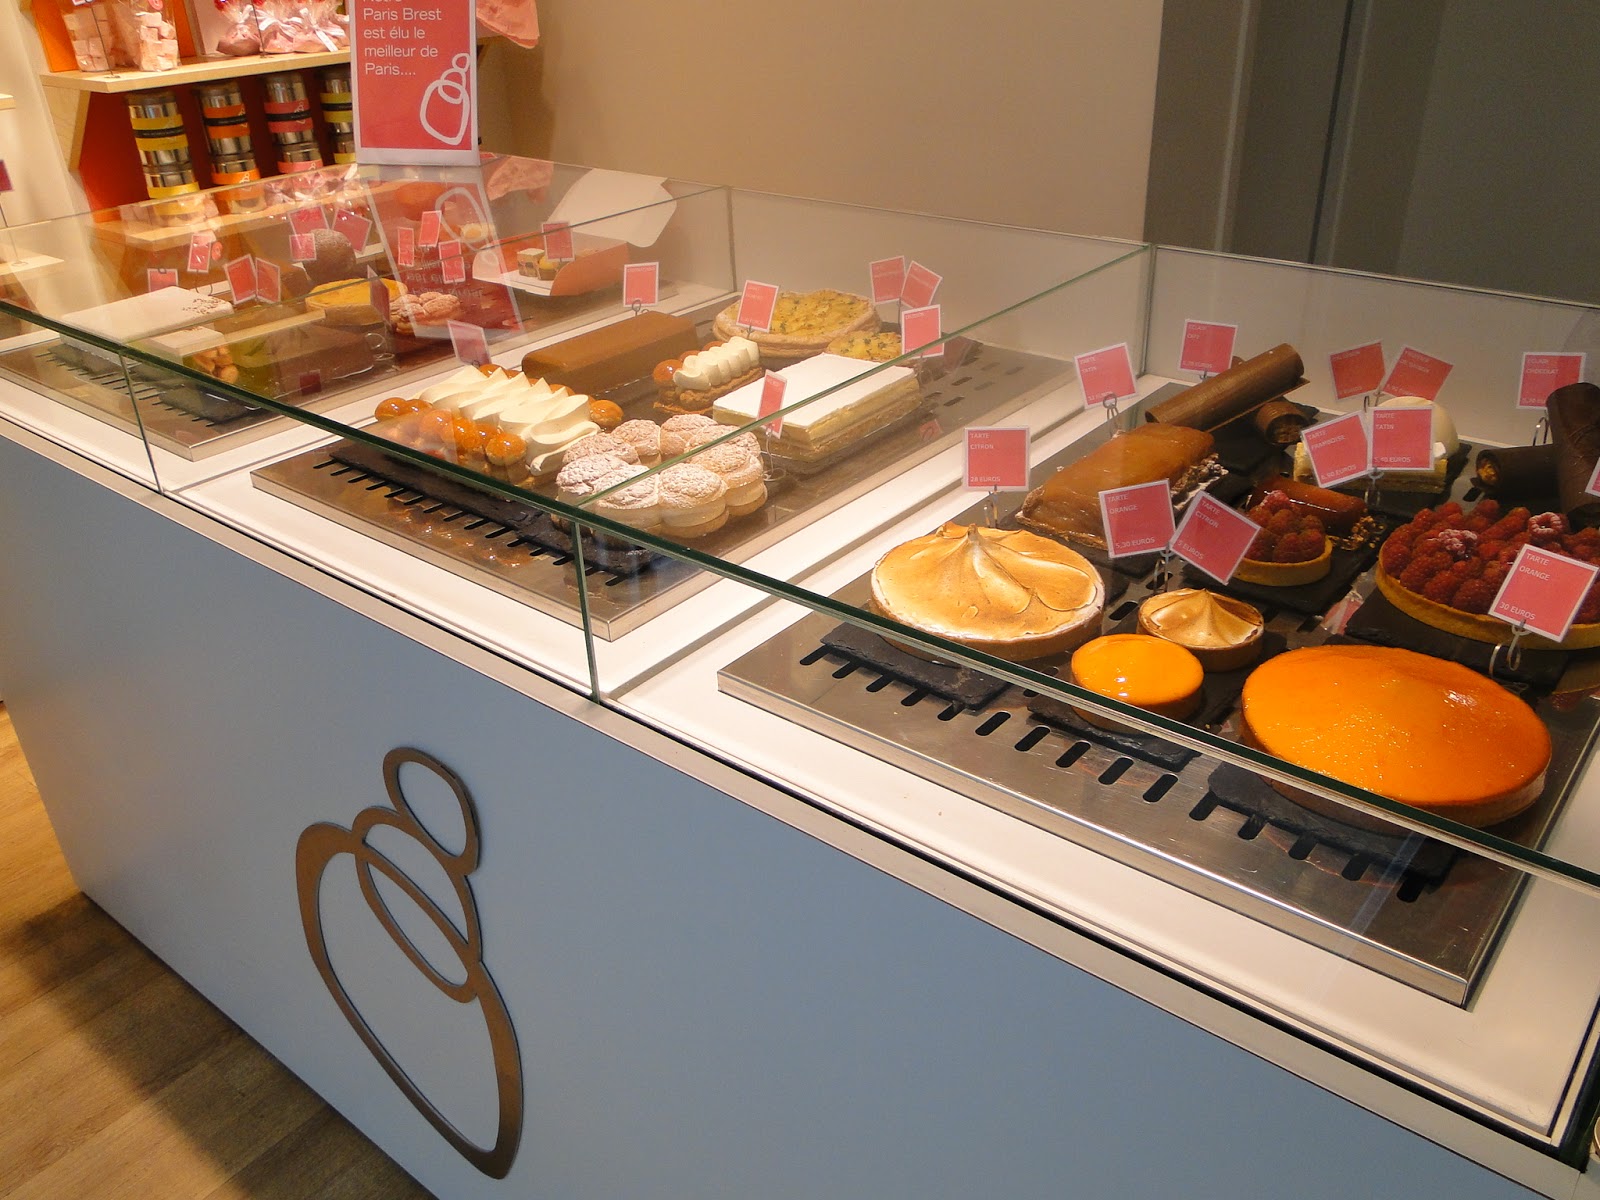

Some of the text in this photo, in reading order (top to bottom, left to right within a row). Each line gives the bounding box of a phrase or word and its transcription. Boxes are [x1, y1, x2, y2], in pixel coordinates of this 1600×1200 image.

[363, 8, 442, 21] Paris Brest
[363, 26, 426, 39] est élu le
[364, 45, 439, 58] meilleur de
[365, 63, 416, 76] Paris....
[1307, 430, 1328, 440] TARTE
[1311, 434, 1346, 450] FRAMBOISE
[1107, 494, 1129, 502] TARTE
[1109, 504, 1138, 515] ORANGE
[1201, 501, 1220, 515] TARTE
[1195, 511, 1219, 528] CITRON
[1132, 537, 1156, 546] EUROS
[1182, 543, 1205, 560] EUROS
[1526, 553, 1550, 566] TARTE
[1519, 565, 1551, 581] ORANGE
[1499, 601, 1536, 620] 30 EUROS
